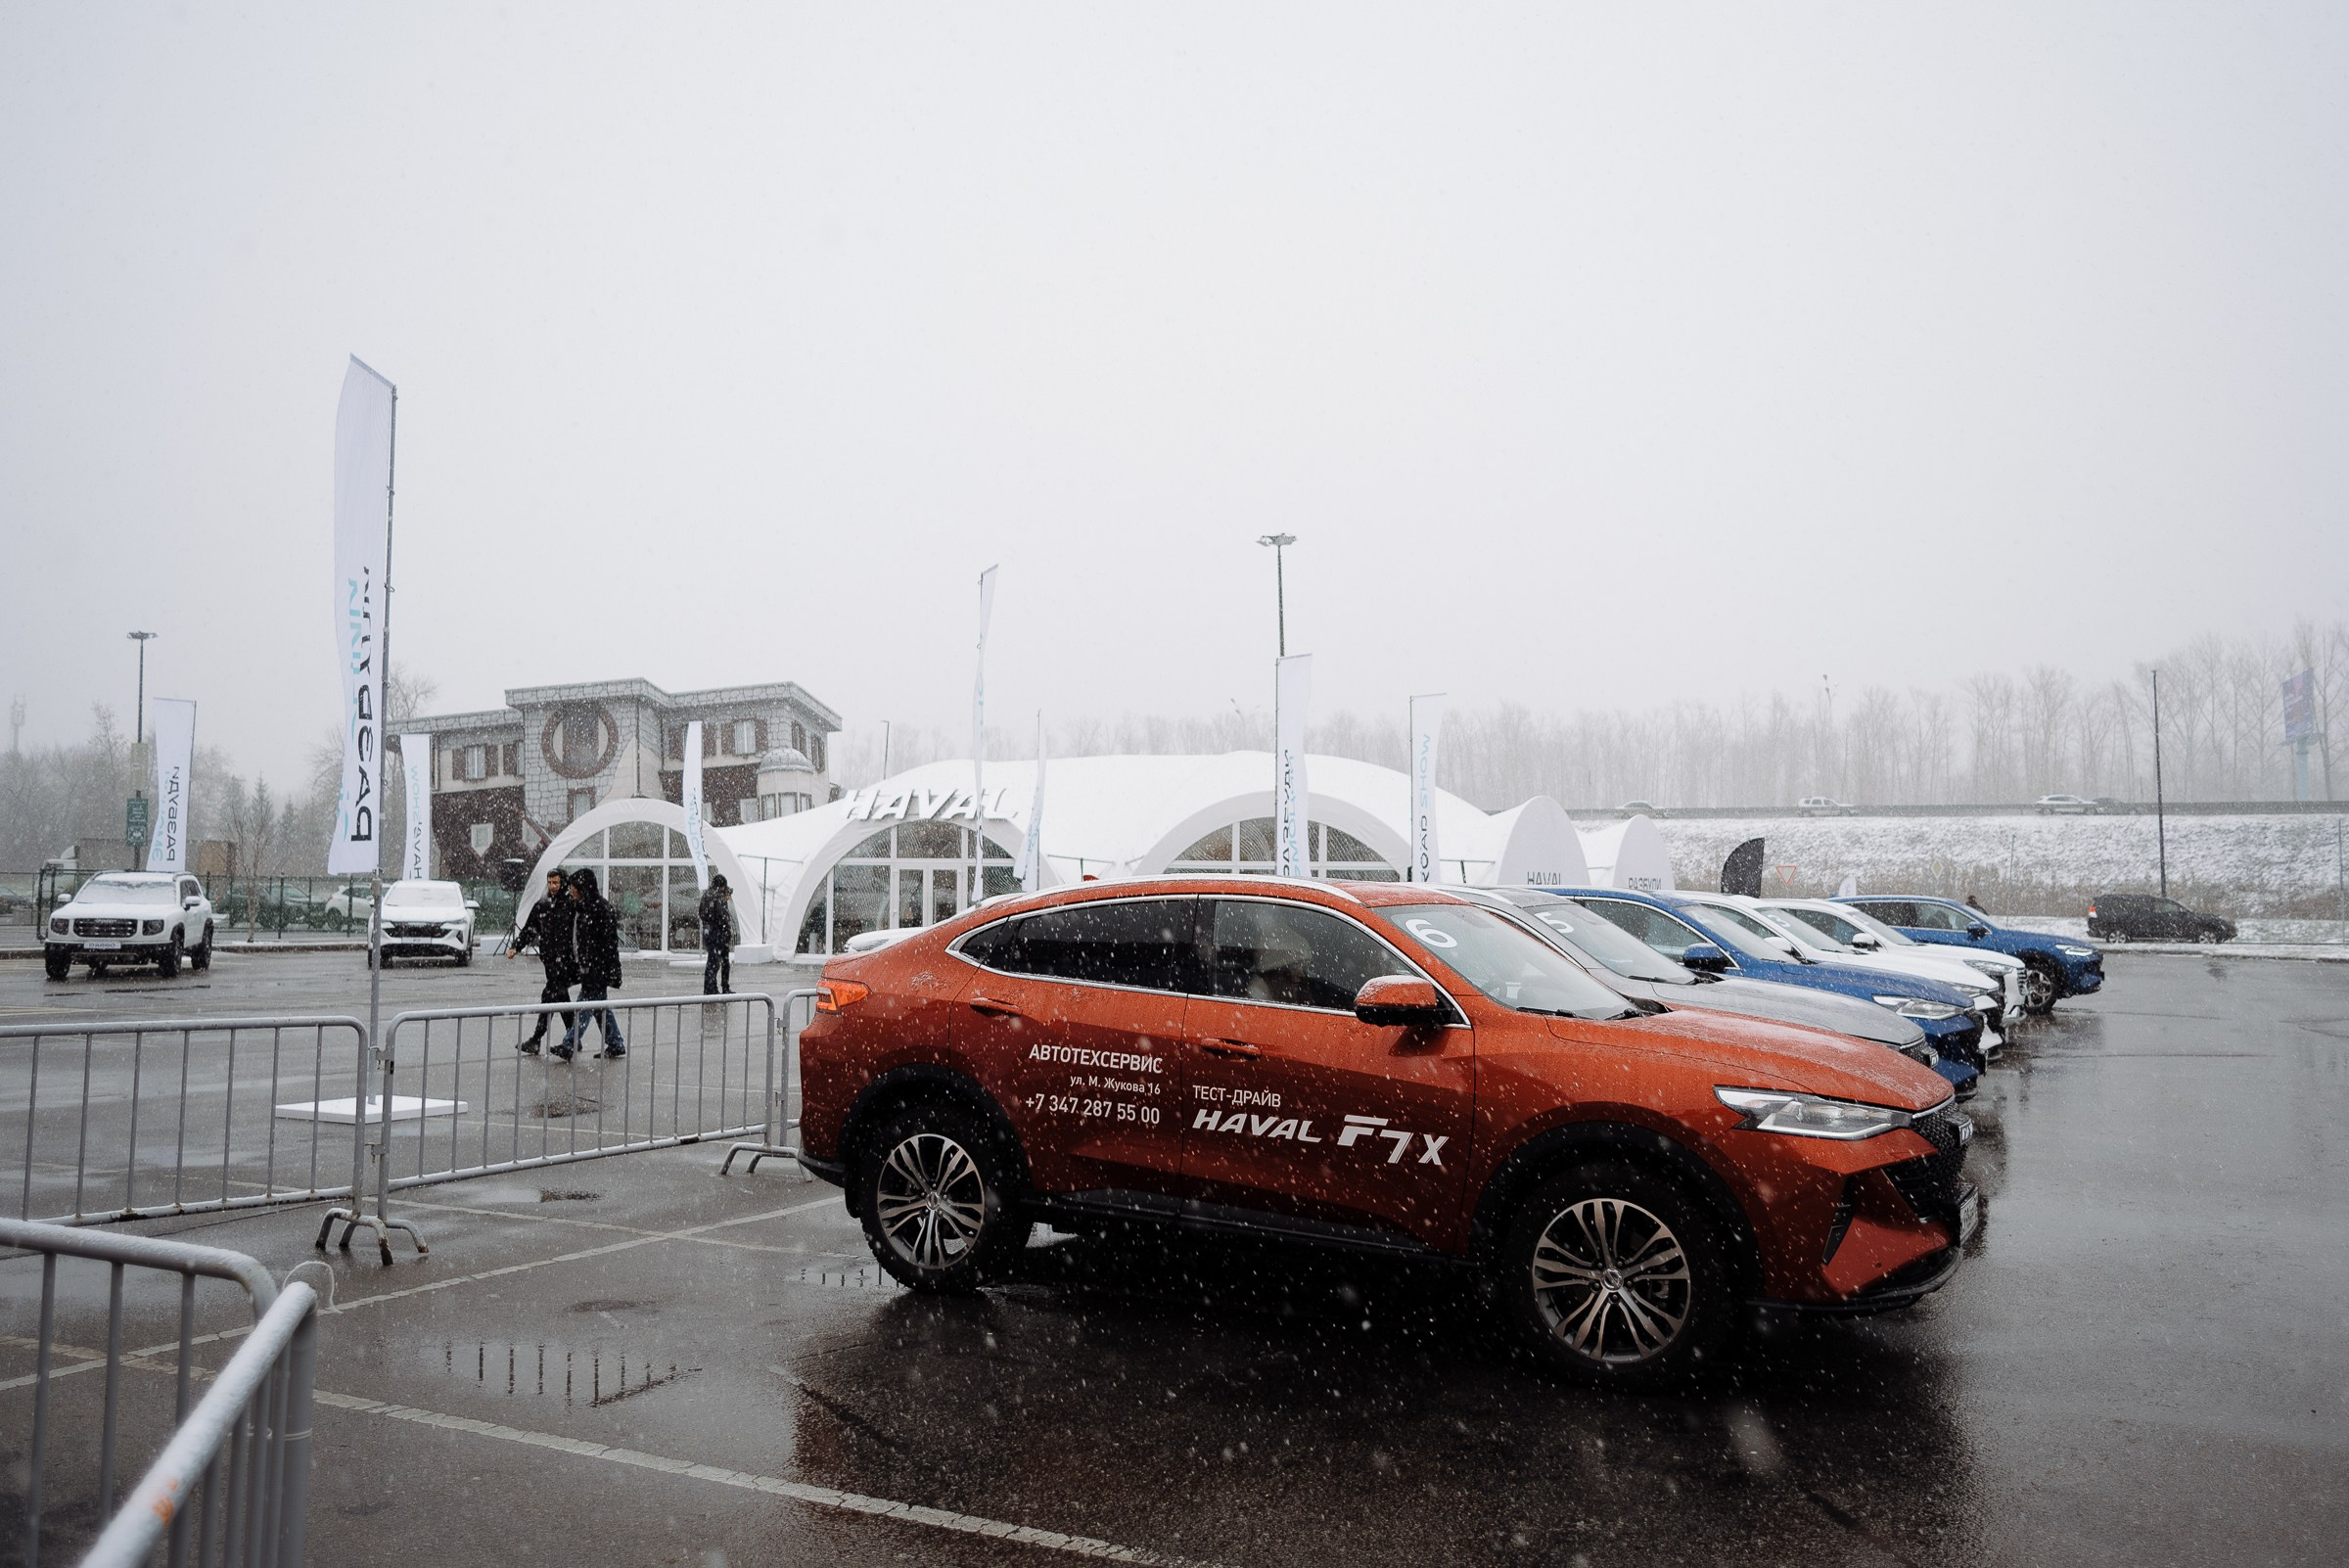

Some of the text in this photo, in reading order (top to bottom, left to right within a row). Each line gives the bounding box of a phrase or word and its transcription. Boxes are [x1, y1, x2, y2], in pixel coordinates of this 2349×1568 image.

[844, 788, 1020, 820] HAVAL
[1405, 918, 1458, 948] 6
[1534, 911, 1575, 934] 5
[1029, 1043, 1163, 1074] АВТОТЕХСЕРВИС
[1070, 1076, 1161, 1094] ул. М. Жукова 16
[1192, 1084, 1281, 1108] ТЕСТ-ДРАЙВ
[1025, 1093, 1160, 1125] +7 347 287 55 00
[1192, 1108, 1322, 1143] HAVAL
